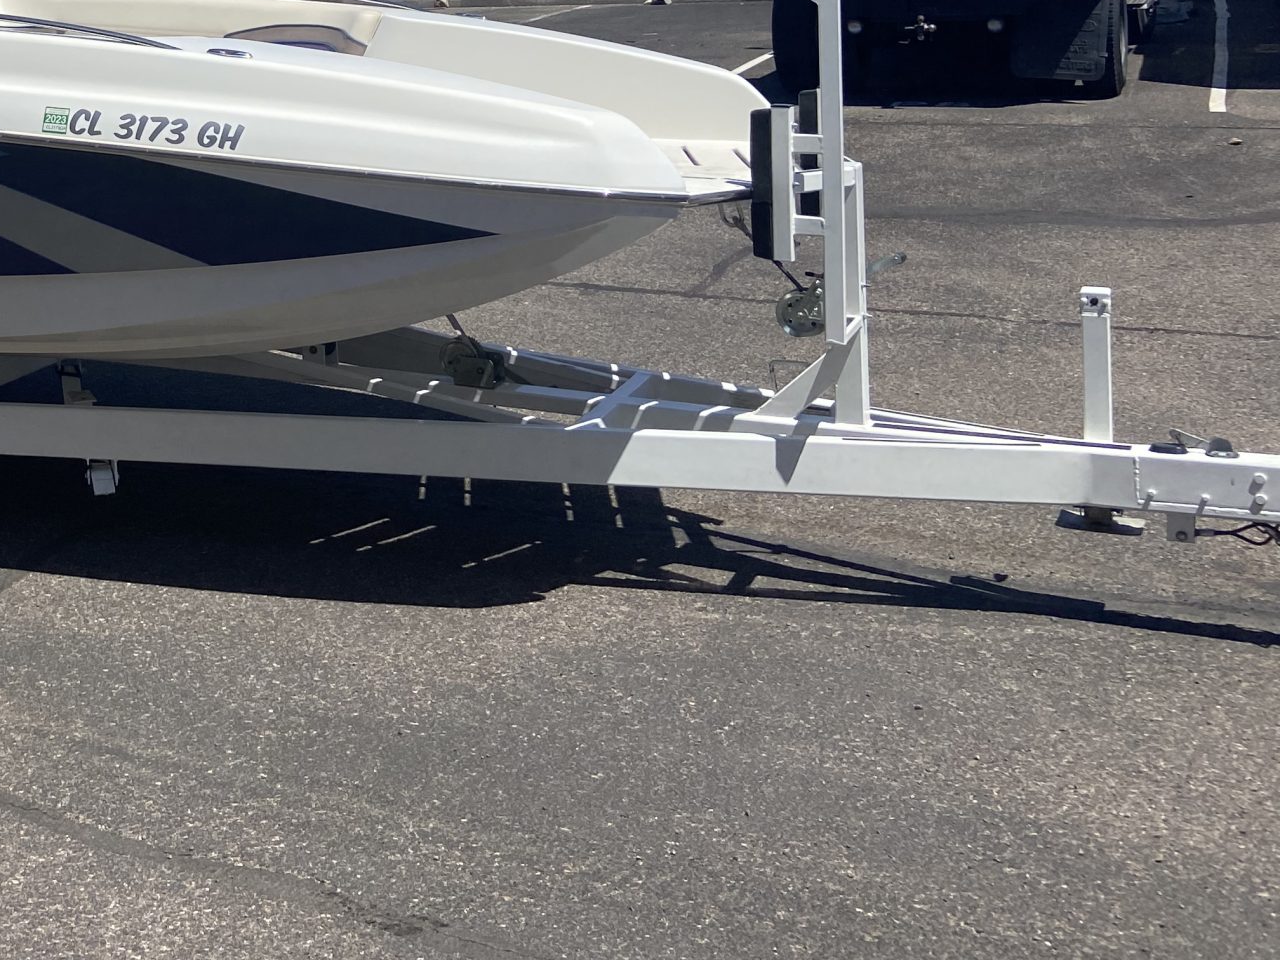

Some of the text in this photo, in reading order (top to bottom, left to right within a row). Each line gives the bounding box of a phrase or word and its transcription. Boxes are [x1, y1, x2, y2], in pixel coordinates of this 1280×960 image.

[45, 114, 67, 125] 2023
[69, 108, 246, 151] CL 3173 GH
